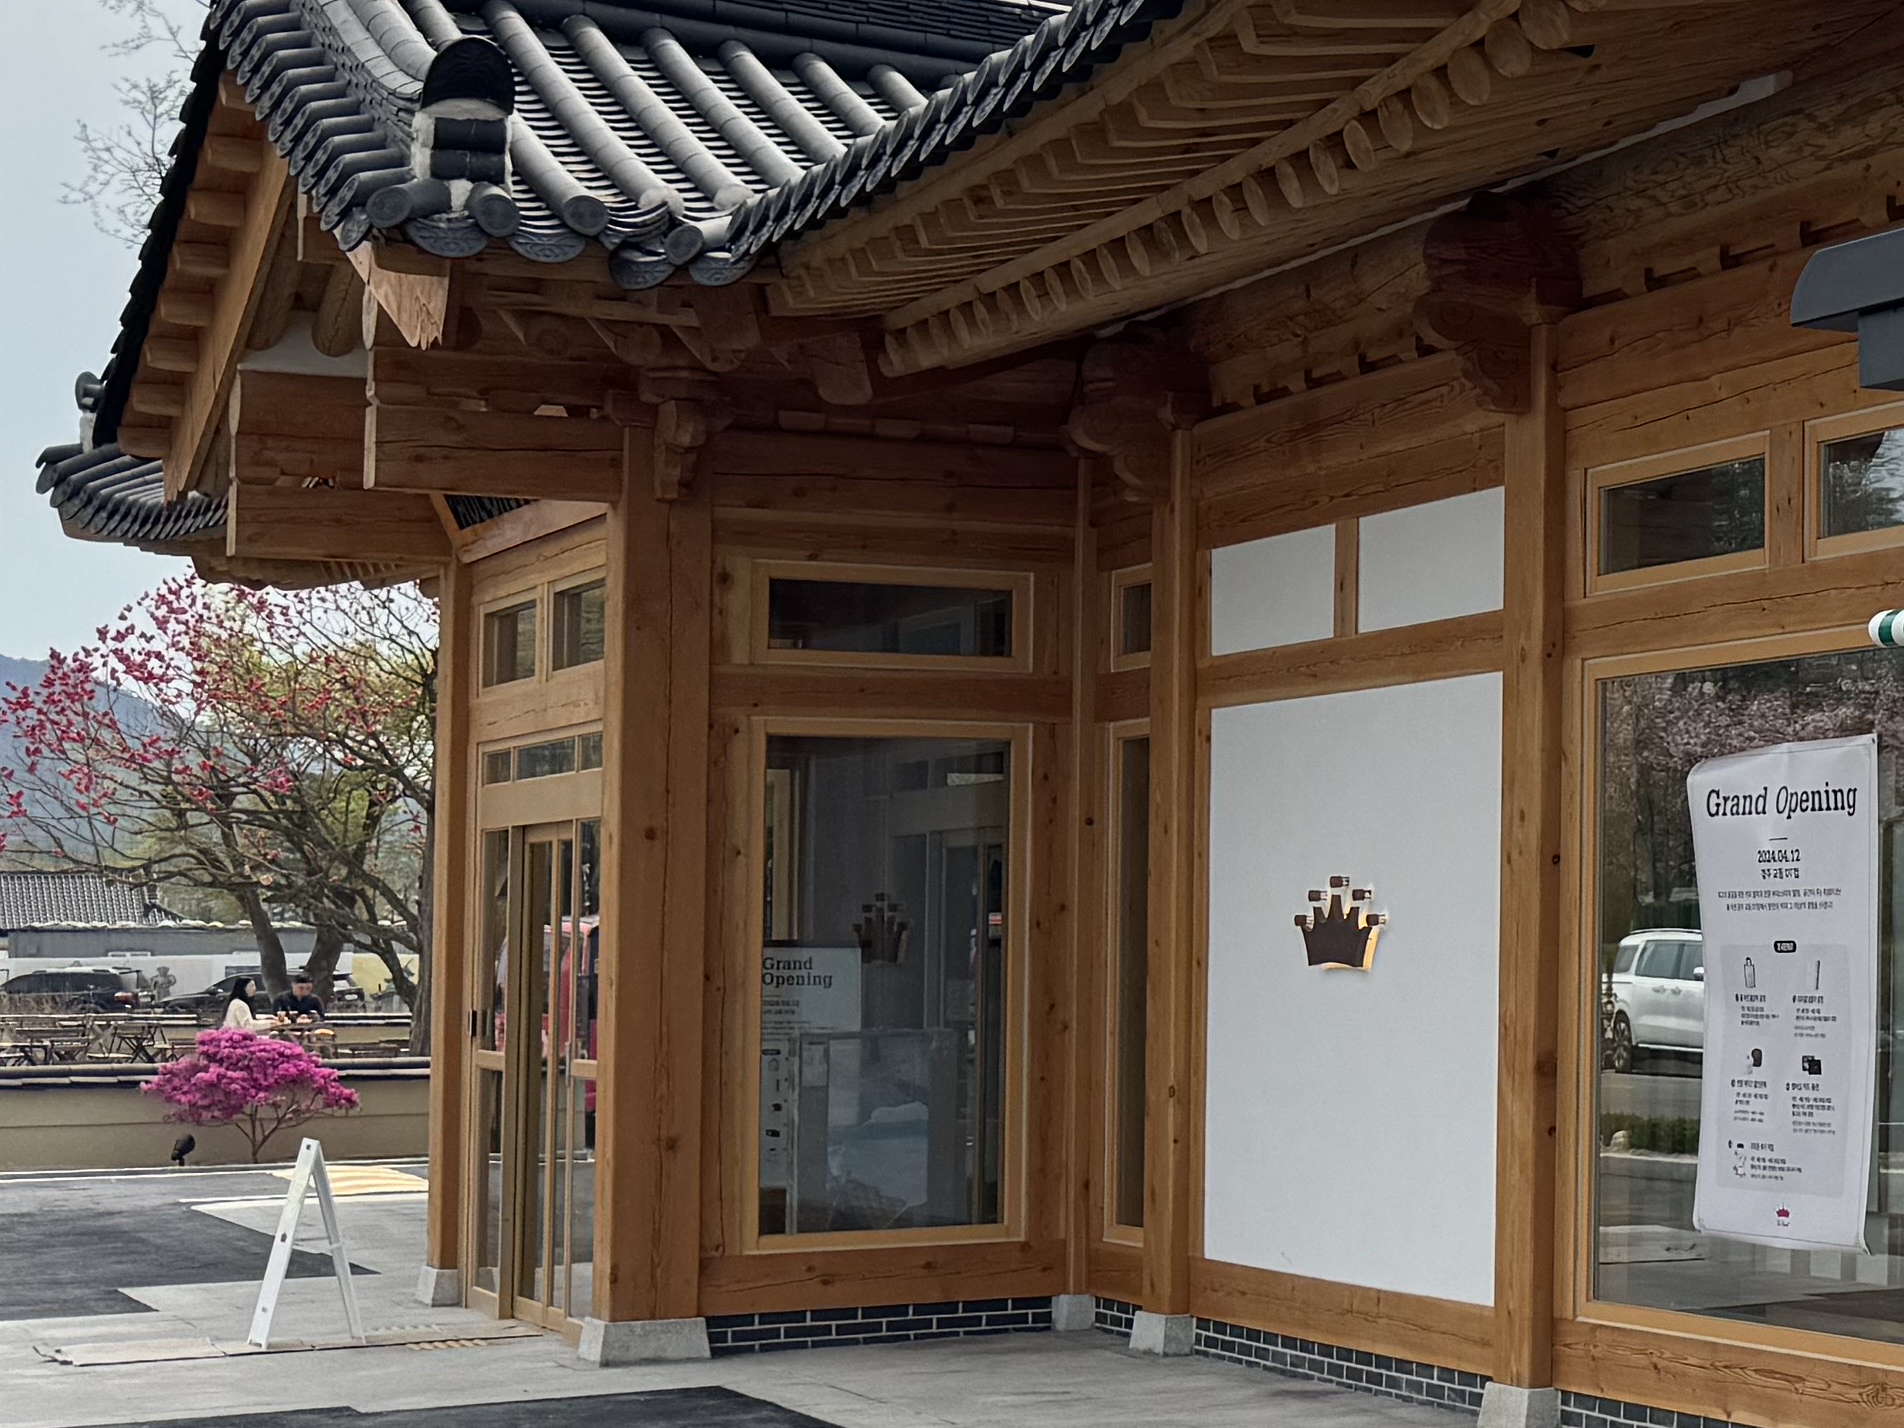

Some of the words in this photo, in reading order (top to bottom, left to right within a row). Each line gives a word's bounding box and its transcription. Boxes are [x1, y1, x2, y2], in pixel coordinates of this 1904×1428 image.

[1706, 786, 1768, 818] Grand
[1775, 781, 1858, 819] Opening
[762, 956, 813, 971] Grand
[762, 971, 833, 989] Opening
